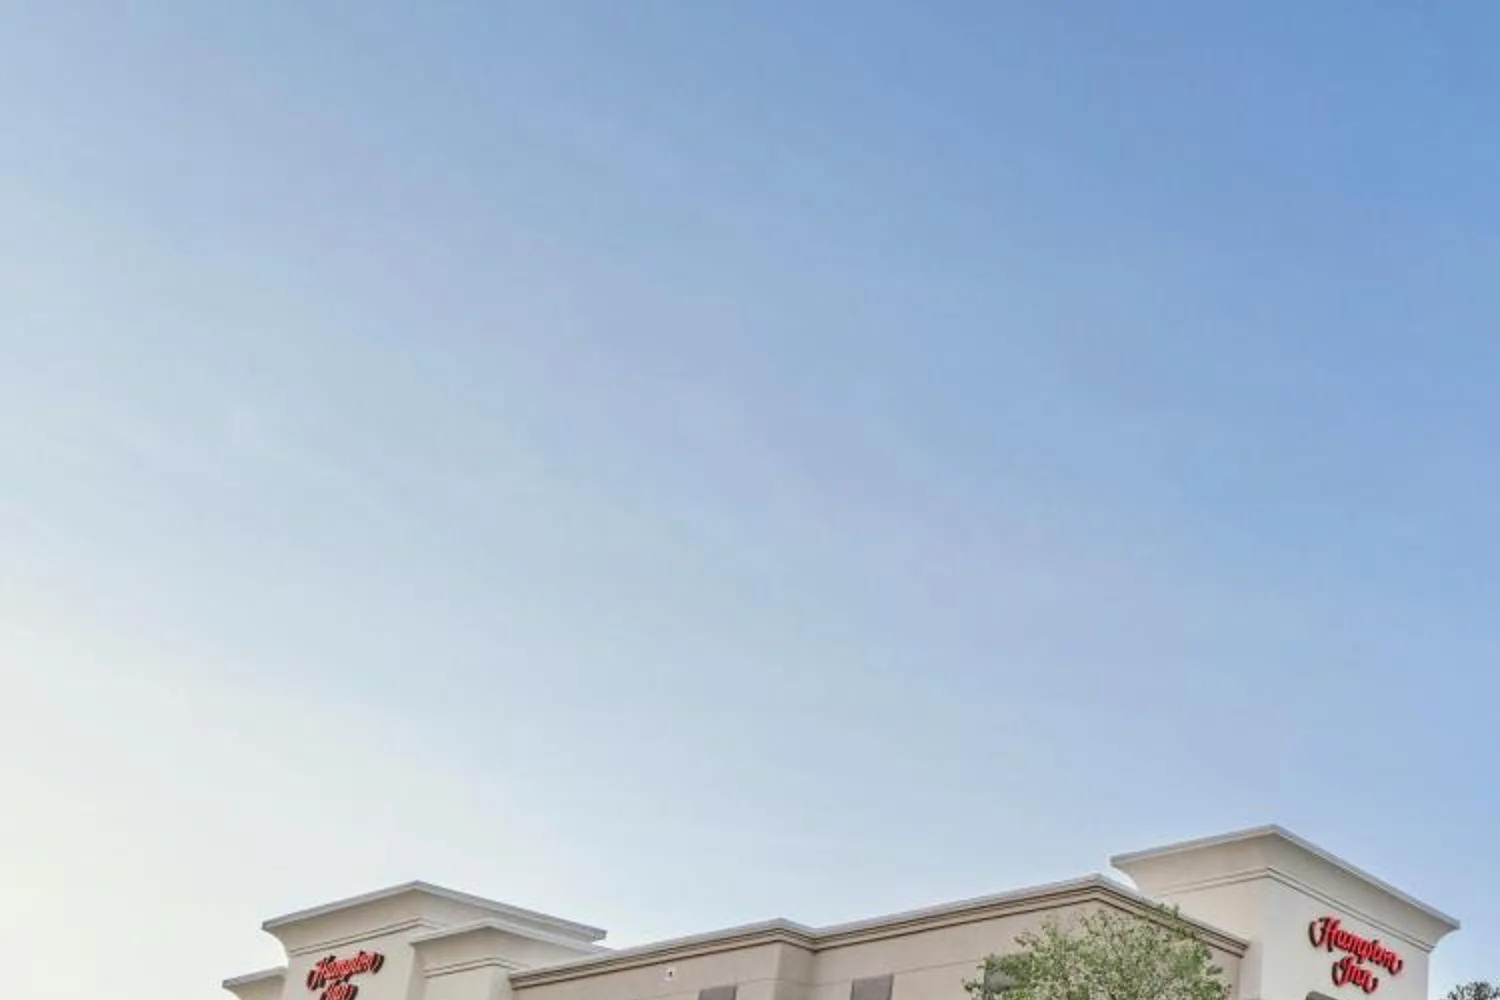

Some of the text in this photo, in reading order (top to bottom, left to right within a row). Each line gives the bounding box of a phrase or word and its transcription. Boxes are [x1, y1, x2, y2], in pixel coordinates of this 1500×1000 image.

[1308, 917, 1403, 975] Hampton
[306, 950, 385, 990] Hampton
[1332, 956, 1378, 994] Inn
